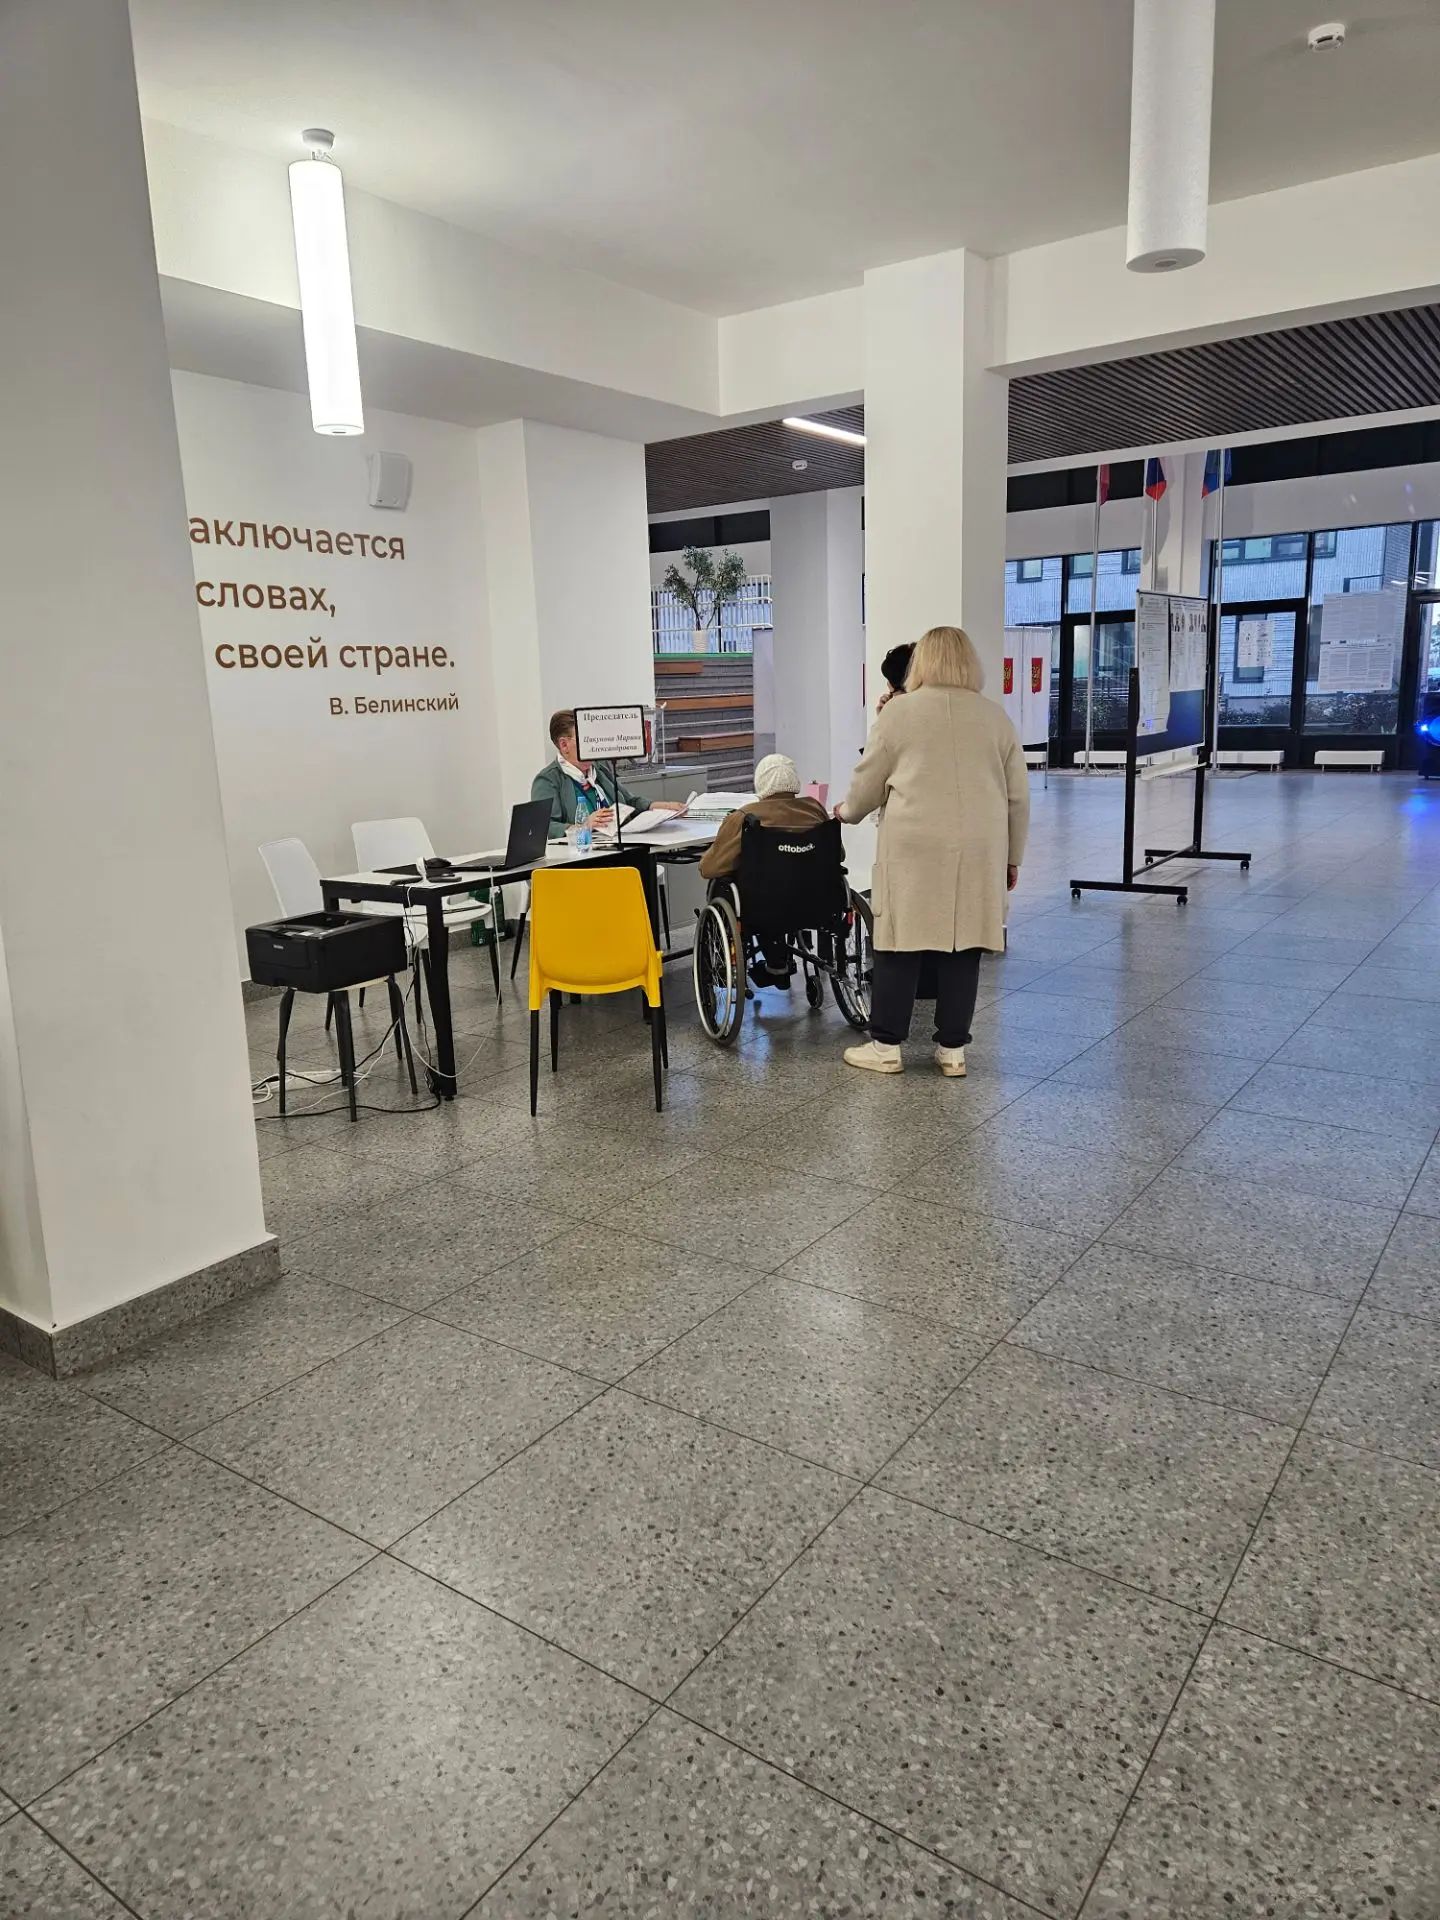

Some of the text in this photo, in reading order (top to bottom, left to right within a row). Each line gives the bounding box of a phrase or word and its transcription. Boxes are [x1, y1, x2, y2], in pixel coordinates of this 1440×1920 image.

[189, 518, 404, 560] аключается
[196, 582, 335, 617] словах,
[216, 637, 454, 675] своей стране.
[330, 693, 458, 715] В. Белинский
